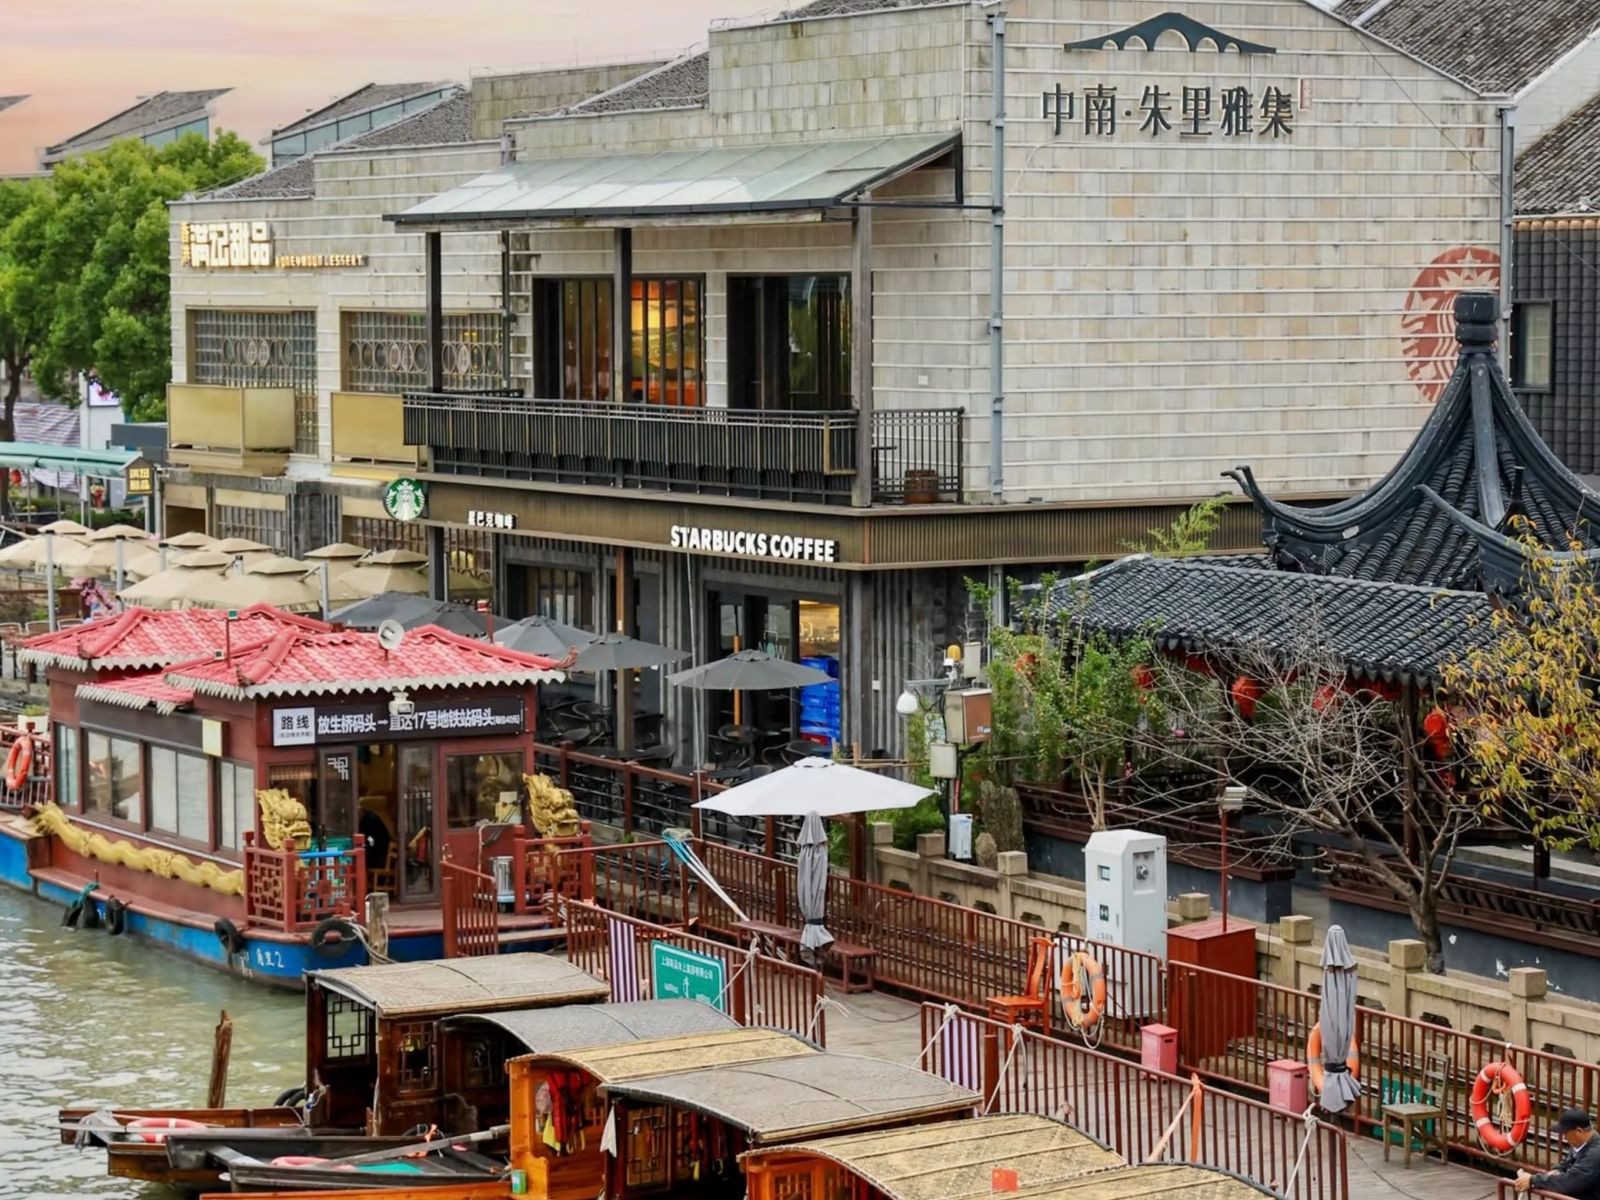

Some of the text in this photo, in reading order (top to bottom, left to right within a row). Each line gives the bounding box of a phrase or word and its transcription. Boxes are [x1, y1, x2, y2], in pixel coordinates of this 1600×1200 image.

[1042, 82, 1294, 138] 中南·朱里雅集
[670, 524, 836, 563] STARBUCKS COFFEE
[280, 714, 310, 731] 路线
[317, 712, 377, 735] 放生桥码头
